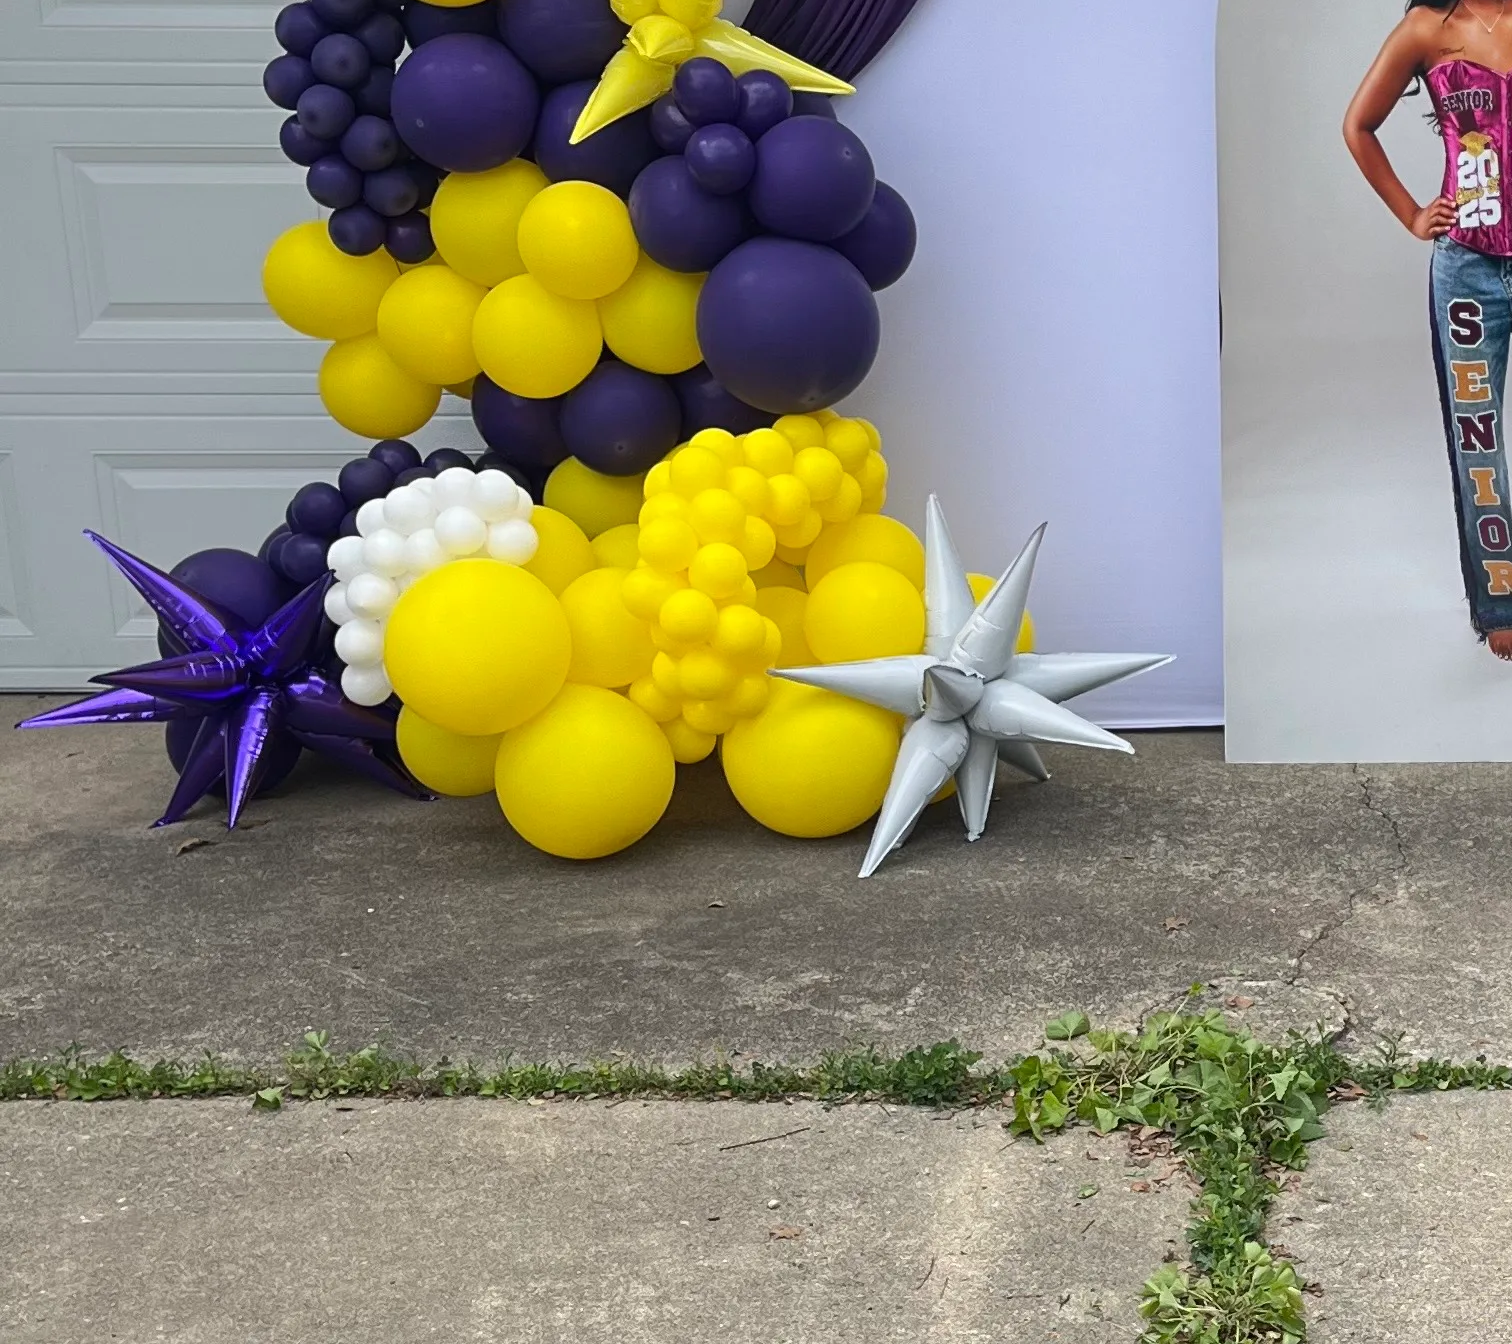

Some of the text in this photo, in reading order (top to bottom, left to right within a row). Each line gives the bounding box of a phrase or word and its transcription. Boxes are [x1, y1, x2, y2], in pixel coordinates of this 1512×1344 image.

[1440, 88, 1493, 112] SENIOR
[1457, 148, 1500, 189] 20
[1459, 189, 1502, 229] 25
